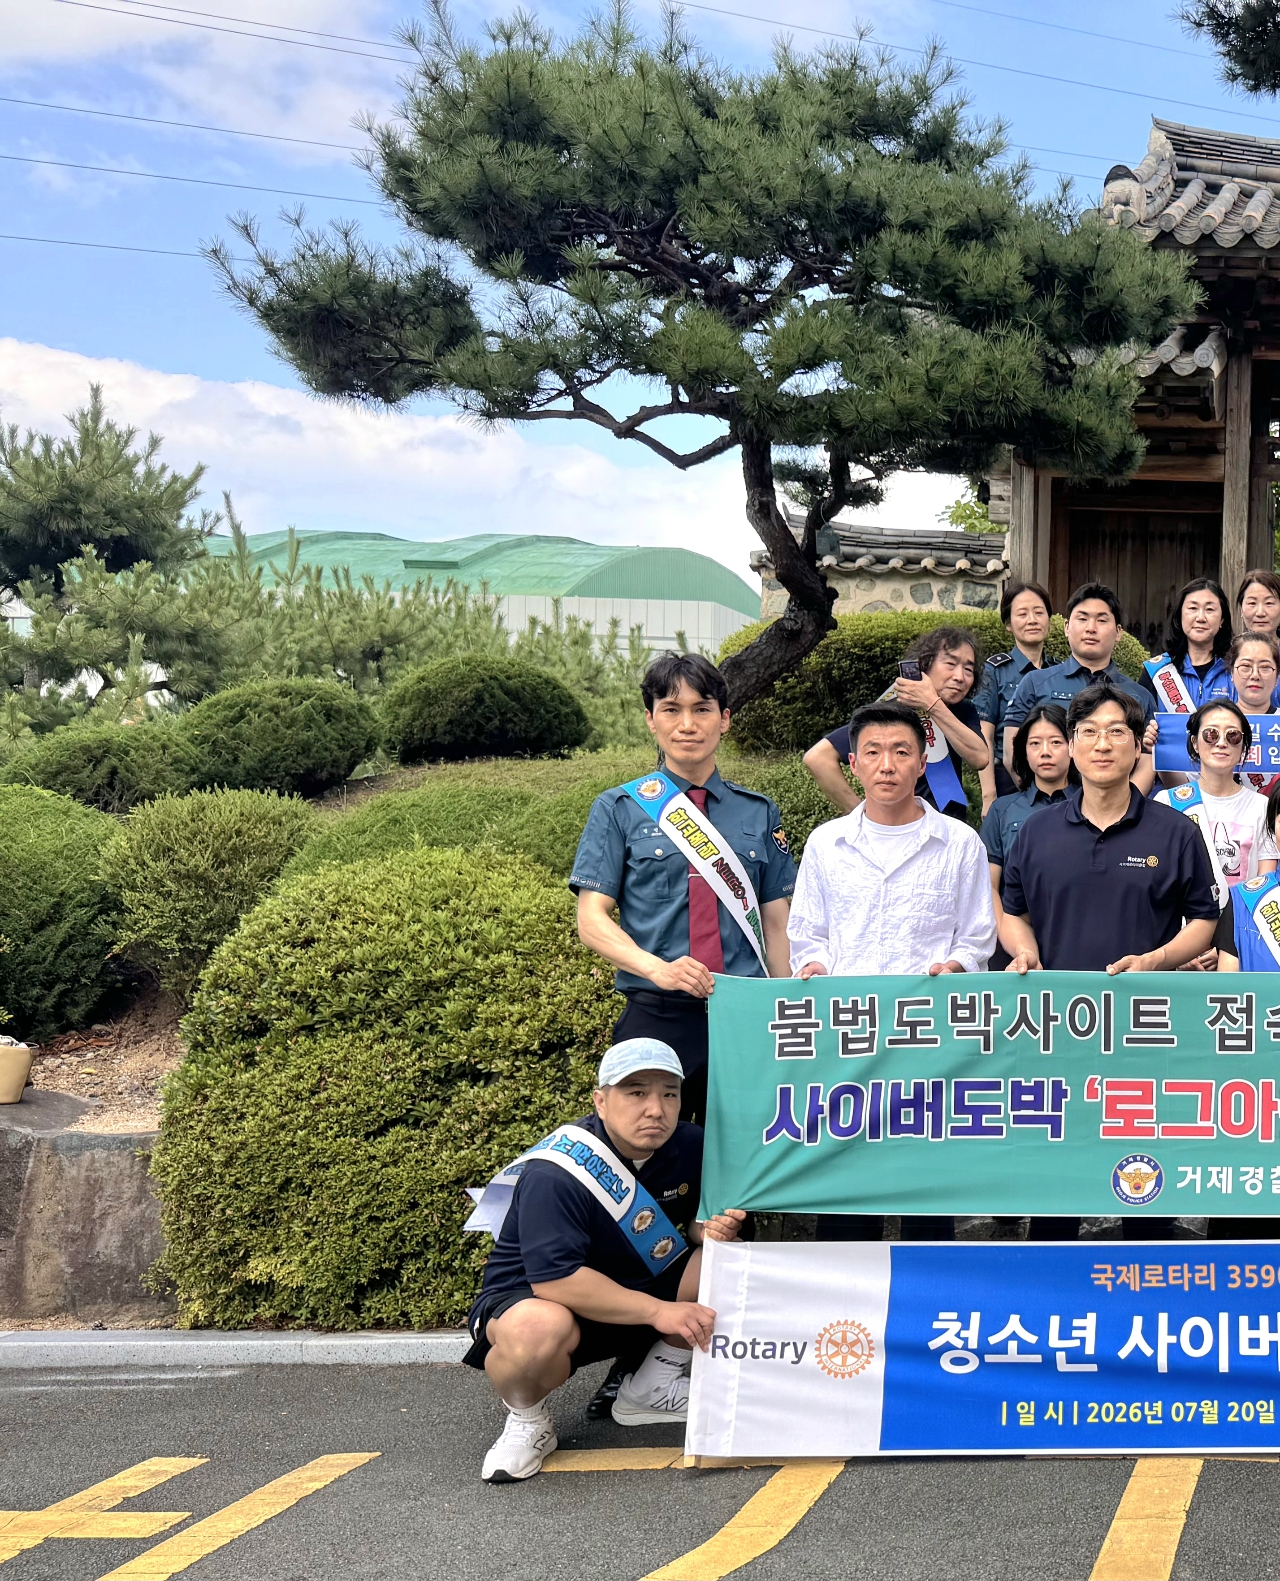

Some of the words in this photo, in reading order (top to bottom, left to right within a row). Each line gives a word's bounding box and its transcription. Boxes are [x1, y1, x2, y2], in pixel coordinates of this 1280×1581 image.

[665, 807, 721, 861] 학교폭력
[768, 991, 1178, 1060] 불법도박사이트
[762, 1077, 1069, 1147] 사이버도박
[1090, 1262, 1217, 1292] 국제로타리
[711, 1334, 808, 1365] Rotary
[927, 1311, 1099, 1374] 청소년
[1087, 1401, 1164, 1425] 2026년
[1171, 1400, 1219, 1425] 07월
[1227, 1399, 1276, 1424] 20일
